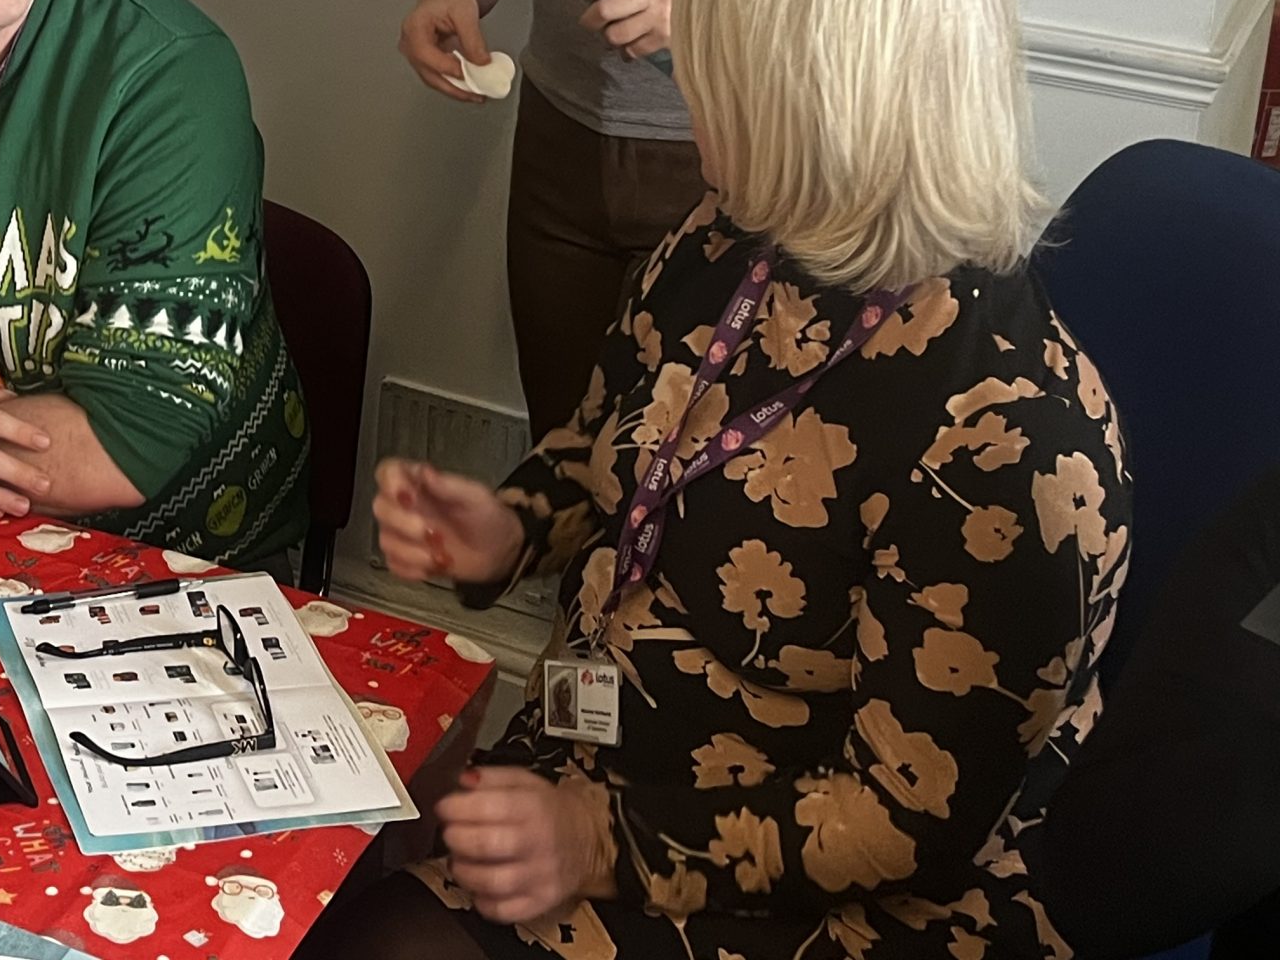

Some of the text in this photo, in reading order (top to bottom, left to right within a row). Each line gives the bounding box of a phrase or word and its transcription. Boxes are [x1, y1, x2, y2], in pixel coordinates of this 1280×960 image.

[731, 299, 756, 330] lotus
[750, 401, 785, 423] lotus
[248, 447, 277, 490] GRINCH
[649, 459, 668, 491] lotus
[635, 523, 654, 553] lotus
